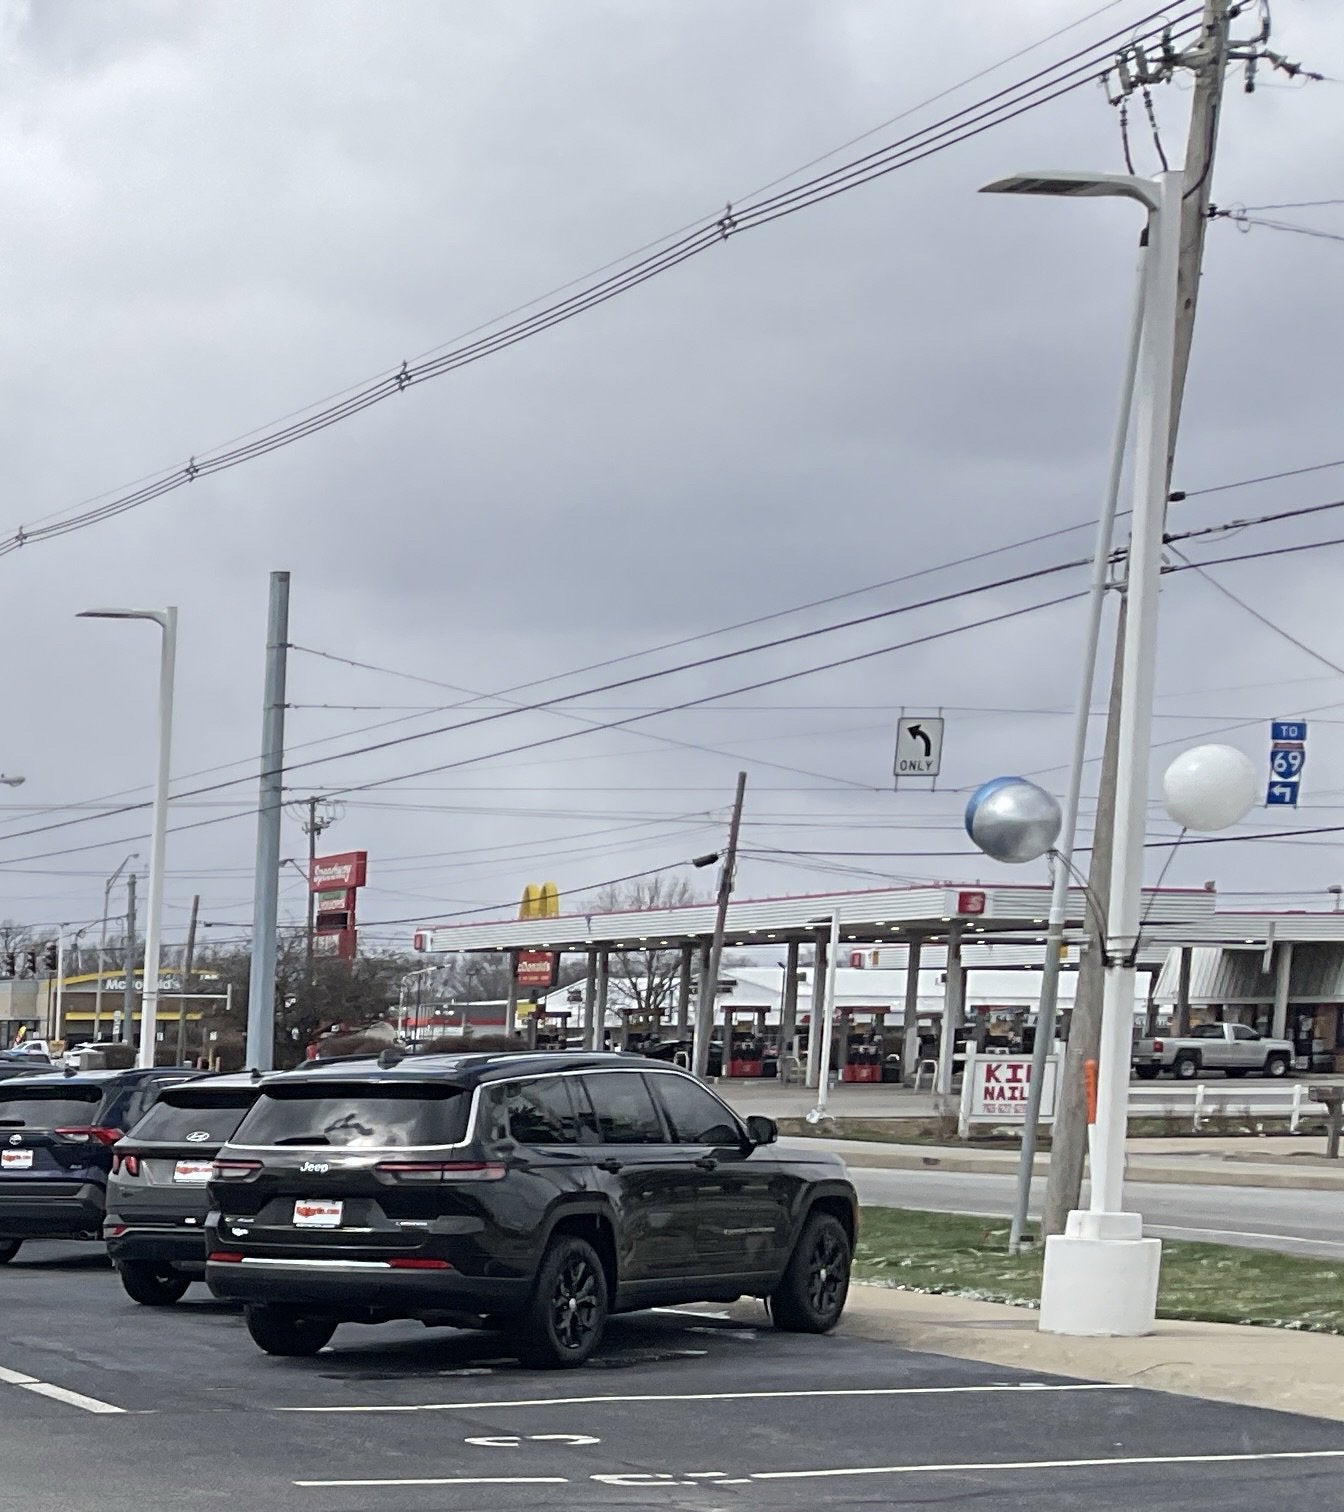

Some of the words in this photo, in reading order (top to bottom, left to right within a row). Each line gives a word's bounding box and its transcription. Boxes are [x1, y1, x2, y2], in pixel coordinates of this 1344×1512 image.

[1280, 725, 1298, 737] TO
[900, 760, 934, 773] ONLY
[1274, 752, 1302, 772] 69
[300, 1161, 329, 1174] Jeep
